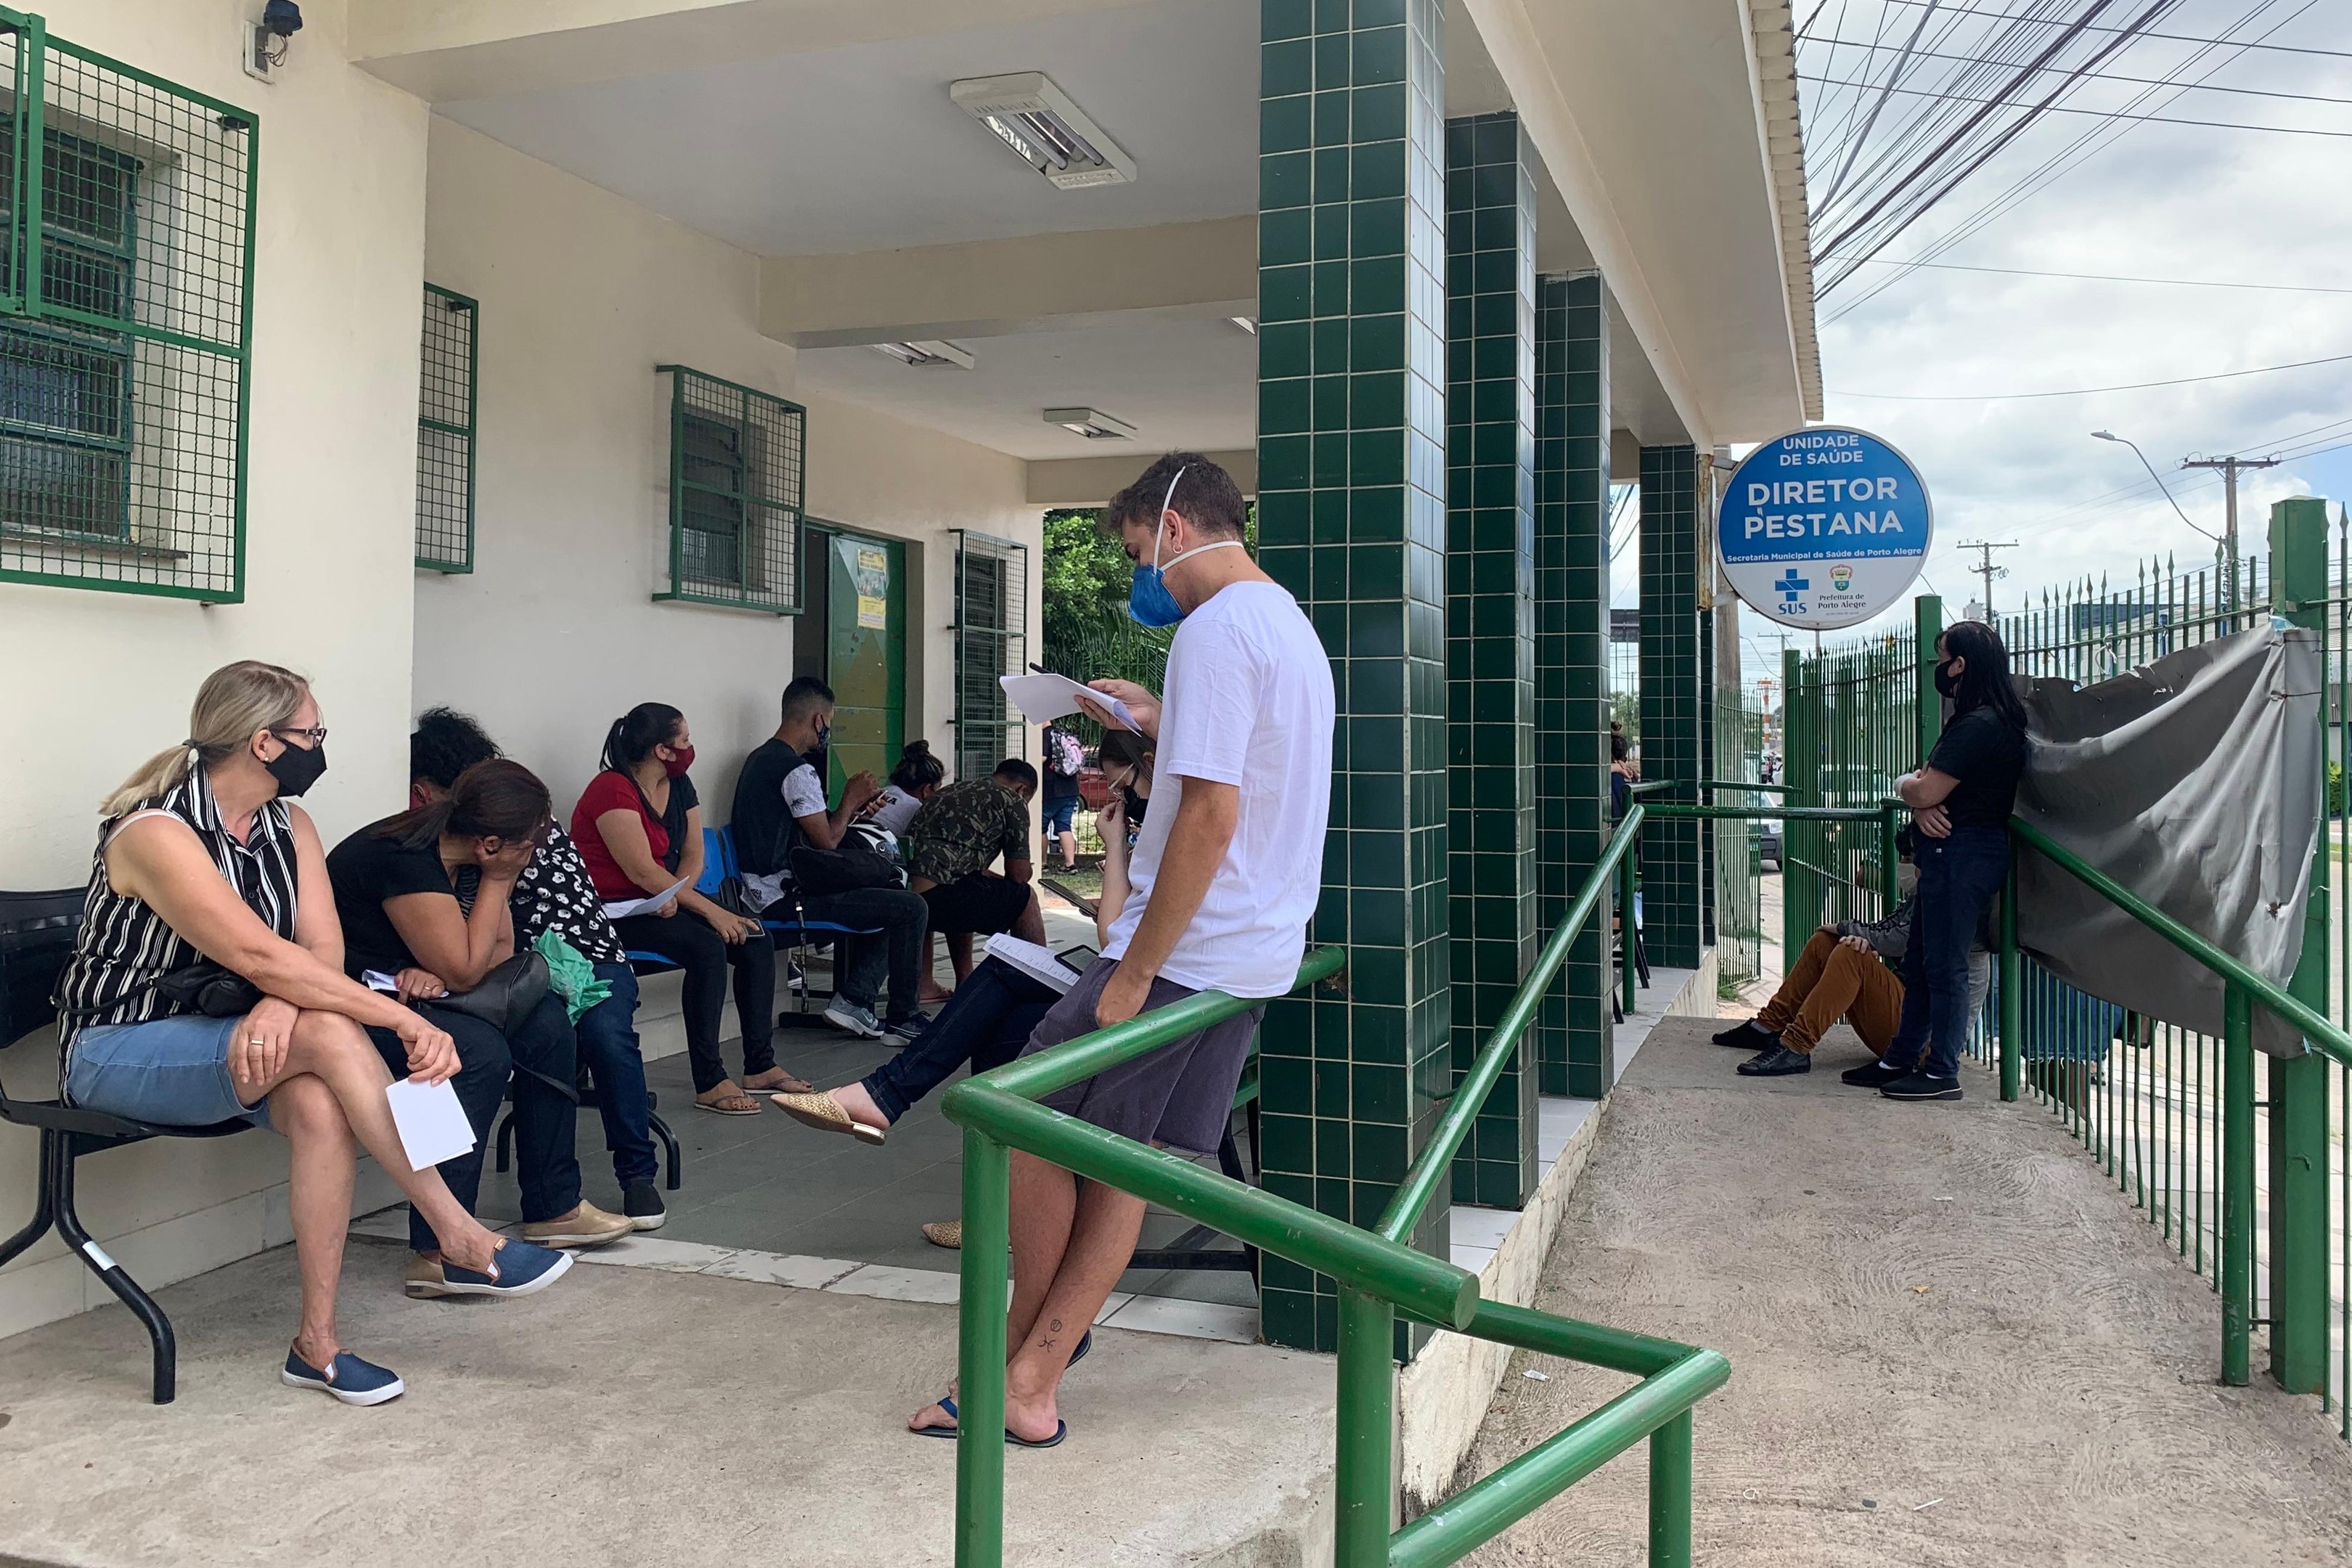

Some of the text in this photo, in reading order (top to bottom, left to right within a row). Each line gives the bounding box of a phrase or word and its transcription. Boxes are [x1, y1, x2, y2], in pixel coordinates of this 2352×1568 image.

[1783, 435, 1859, 450] UNIDADE
[1780, 449, 1863, 467] DE SAÚDE
[1748, 477, 1898, 506] DIRETOR
[1744, 510, 1903, 539] PESTANA
[1771, 552, 1810, 560] Municipal
[1893, 547, 1922, 555] Alegre
[1778, 603, 1808, 615] SUS
[1841, 600, 1866, 609] Alegre
